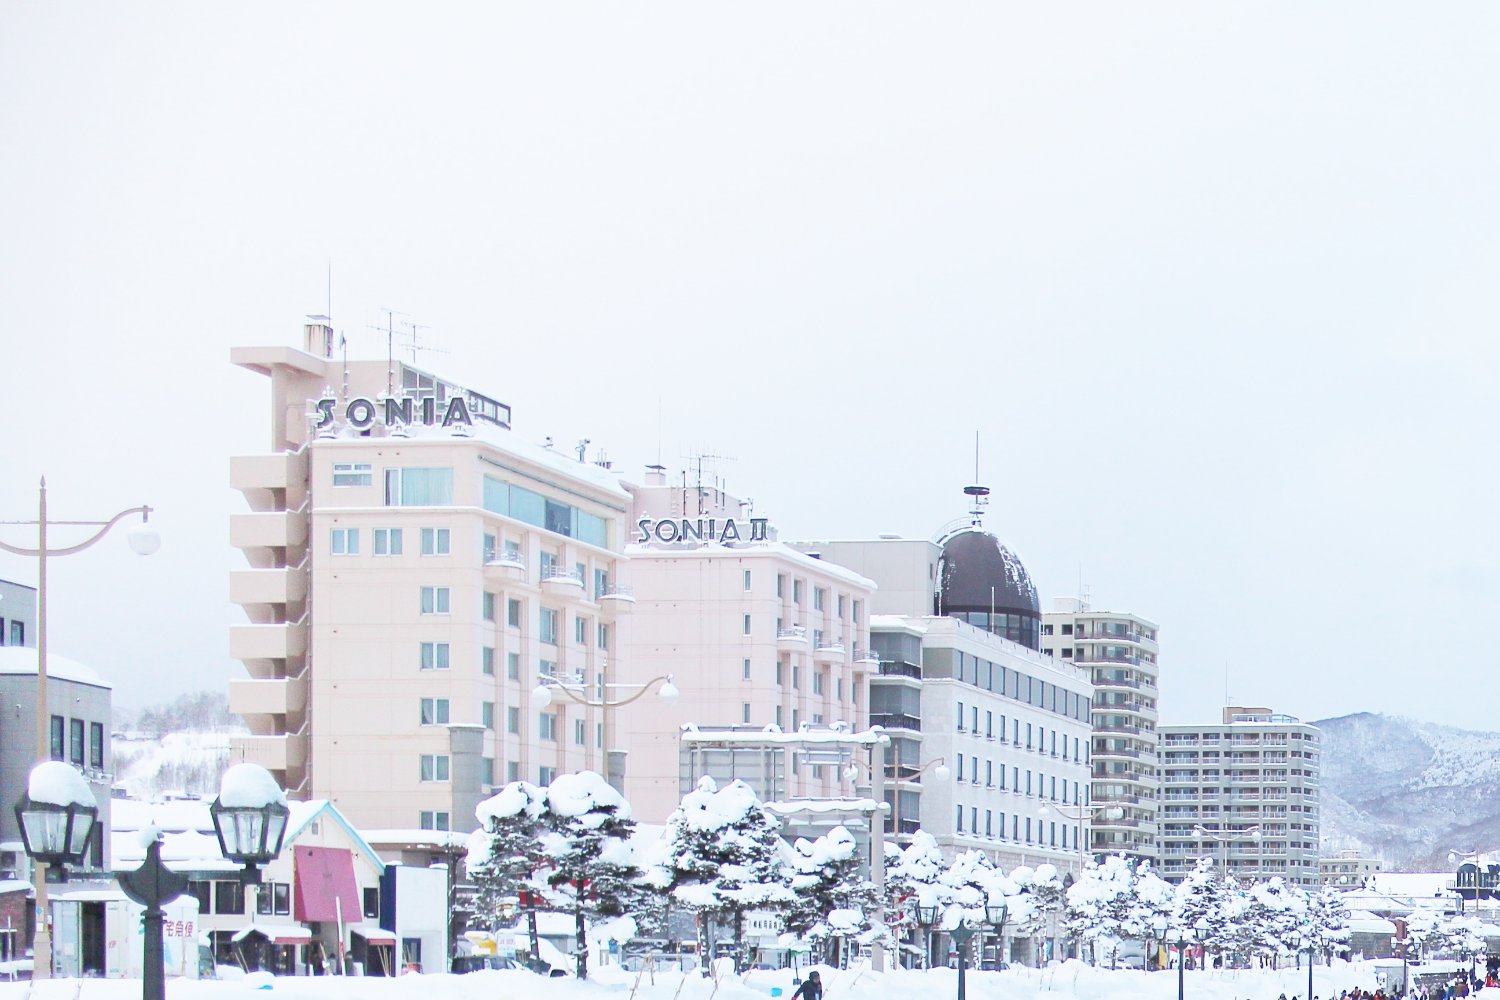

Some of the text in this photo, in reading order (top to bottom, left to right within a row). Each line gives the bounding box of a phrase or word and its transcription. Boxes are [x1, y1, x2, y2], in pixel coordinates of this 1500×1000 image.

[317, 398, 473, 430] SONIA
[638, 519, 741, 543] SONIA
[165, 920, 194, 938] 宅急便
